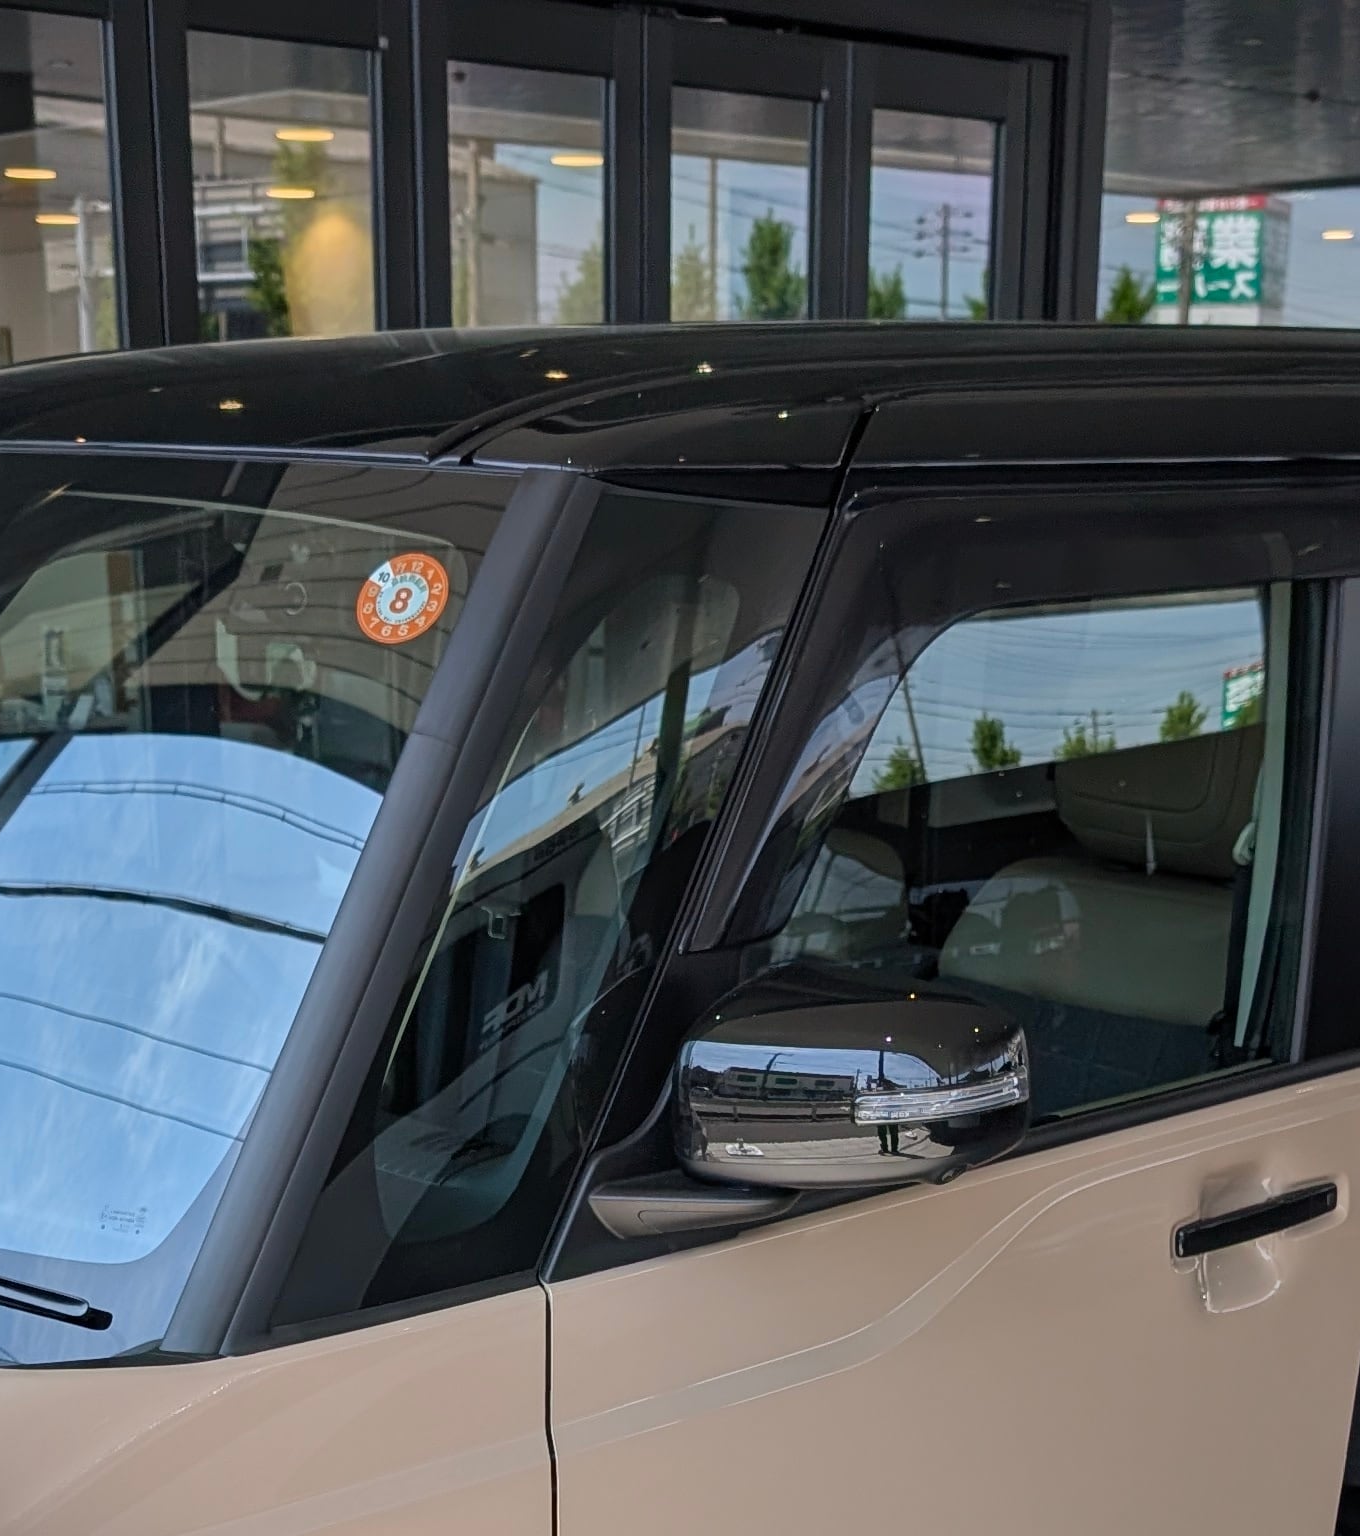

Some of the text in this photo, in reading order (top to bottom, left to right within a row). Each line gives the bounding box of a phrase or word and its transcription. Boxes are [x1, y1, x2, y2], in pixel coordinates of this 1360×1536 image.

[411, 560, 424, 572] 12
[377, 571, 391, 583] 10
[426, 569, 435, 580] 1
[368, 585, 379, 598] 9
[430, 583, 443, 595] 2
[388, 586, 414, 615] 8
[426, 600, 438, 612] 3
[362, 602, 374, 614] 8
[369, 617, 381, 629] 7
[414, 615, 426, 627] 4
[380, 624, 393, 637] 6
[397, 624, 409, 636] 5
